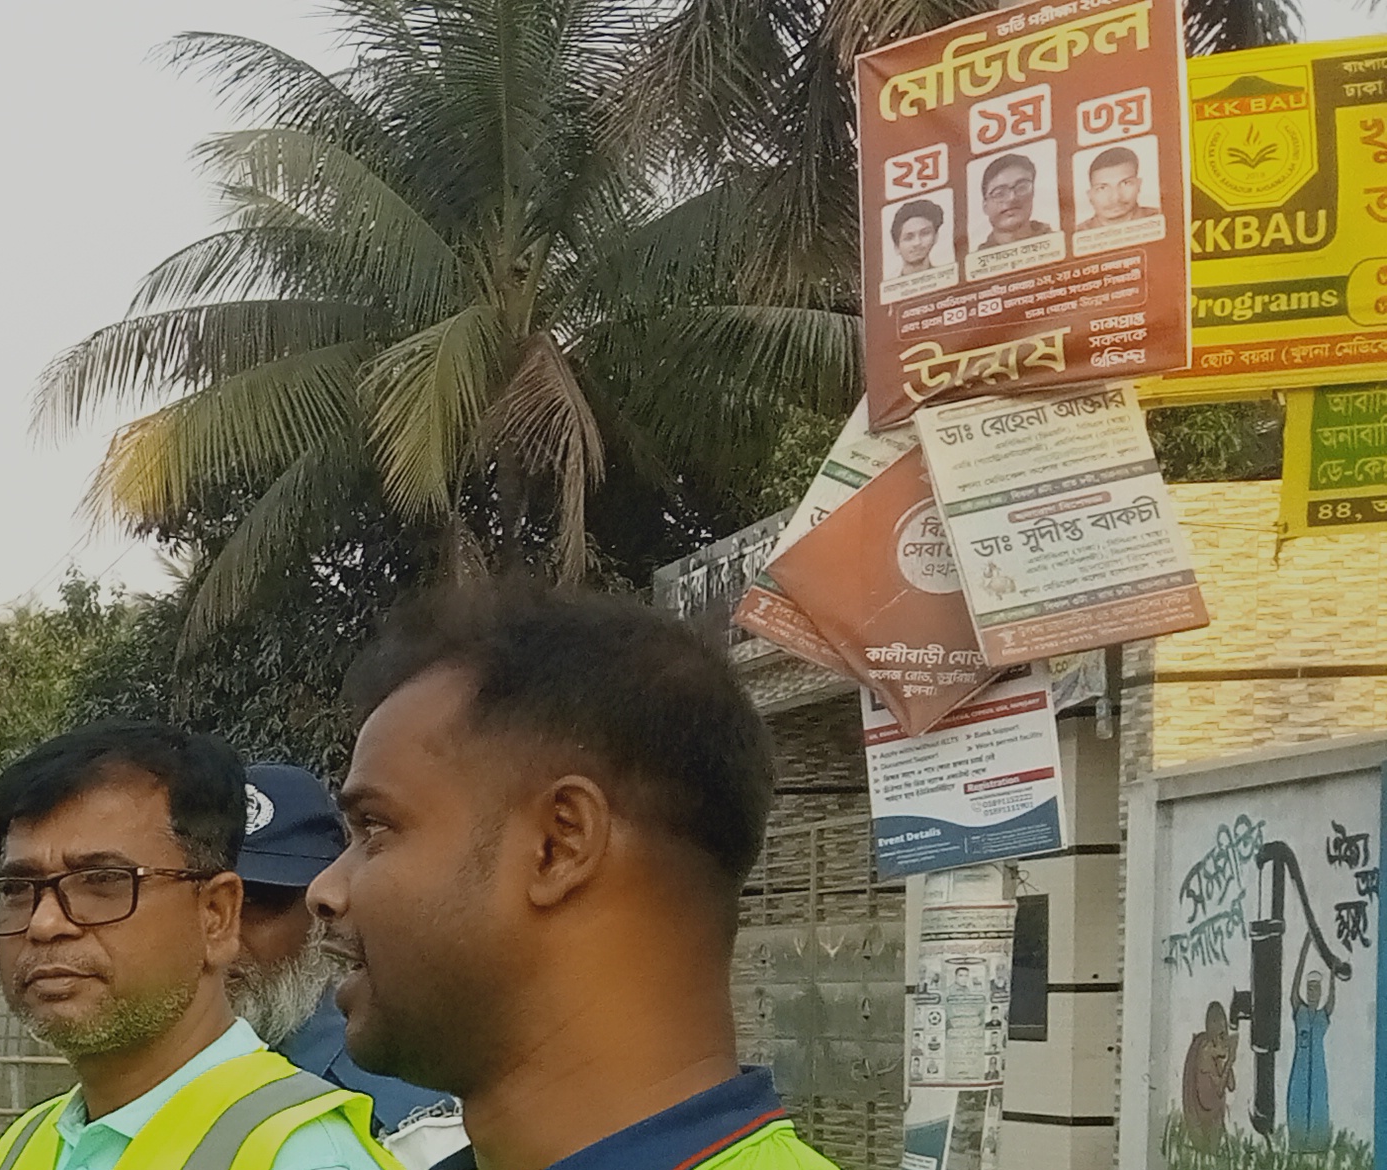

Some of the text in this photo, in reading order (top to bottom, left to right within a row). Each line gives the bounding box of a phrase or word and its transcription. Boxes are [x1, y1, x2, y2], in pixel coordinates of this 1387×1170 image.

[879, 0, 1153, 122] মেডিকেল
[1343, 57, 1387, 74] বাংলা
[1204, 93, 1307, 117] KK BAU
[892, 95, 1145, 188] ২য় ১ম ৩য়
[899, 326, 1072, 401] উন্মেষ
[1201, 349, 1234, 368] ছোট
[1327, 389, 1387, 416] আবা
[936, 423, 974, 446] ডাঃ
[981, 408, 1048, 437] রেহেনা
[1318, 456, 1387, 484] ডে-কে
[971, 535, 1013, 558] ডাঃ
[1018, 517, 1083, 553] সুদীপ্ত
[1087, 495, 1161, 531] বাকচী
[866, 642, 946, 668] কালীবাড়ী
[967, 775, 1019, 792] Registration
[877, 826, 942, 847] Event Details
